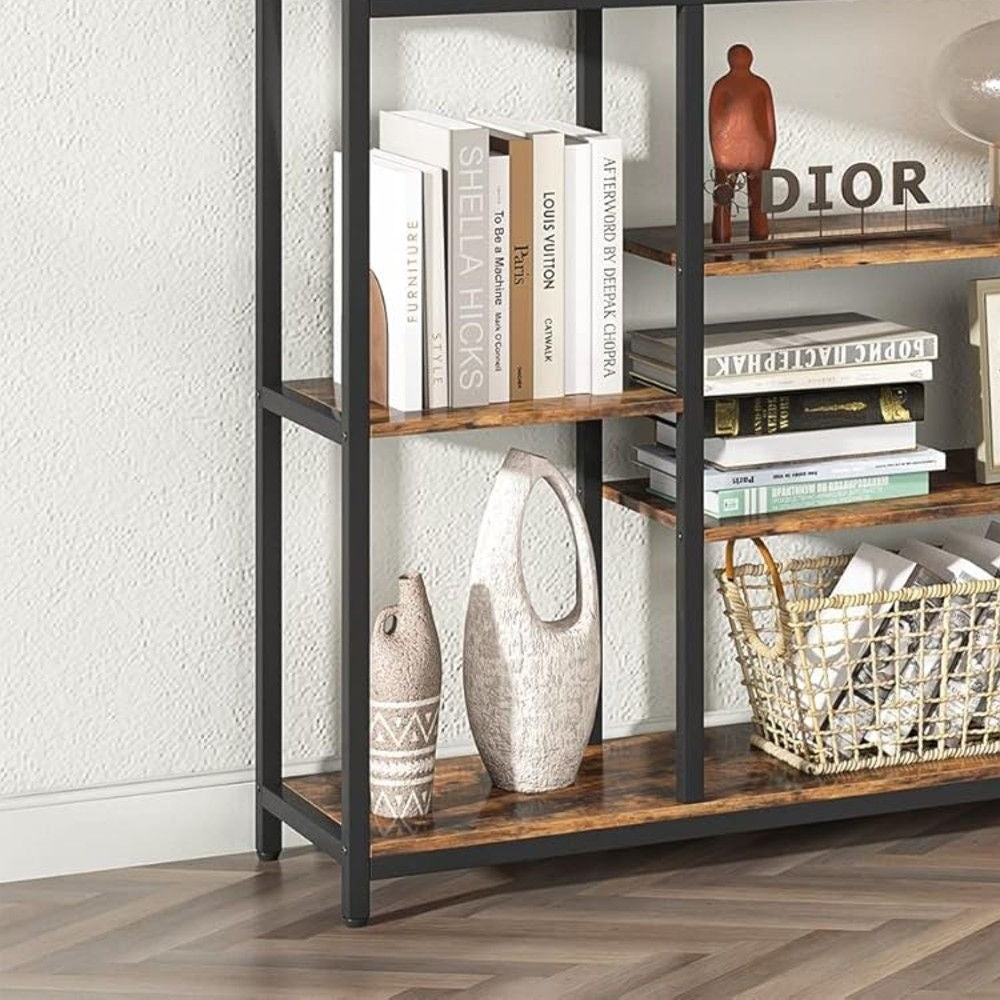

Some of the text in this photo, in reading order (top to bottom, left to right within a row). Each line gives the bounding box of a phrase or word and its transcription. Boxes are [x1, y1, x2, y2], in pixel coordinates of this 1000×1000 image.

[761, 160, 930, 214] DIOR
[494, 211, 505, 225] To
[494, 227, 505, 243] Be
[494, 246, 502, 255] a
[543, 192, 555, 290] LOUIS VUITTON
[407, 221, 419, 323] FURNITURE
[494, 257, 505, 306] Machine
[513, 245, 529, 285] Paris
[602, 157, 616, 379] AFTERWORD BY DEEPAK CHOPRA
[458, 287, 484, 391] HICKS
[494, 312, 503, 332] Mark
[543, 318, 553, 362] CATWALK
[432, 332, 444, 386] STYLE
[715, 339, 926, 377] БОРИС ПАСТЕРНАК
[732, 474, 755, 486] Paris
